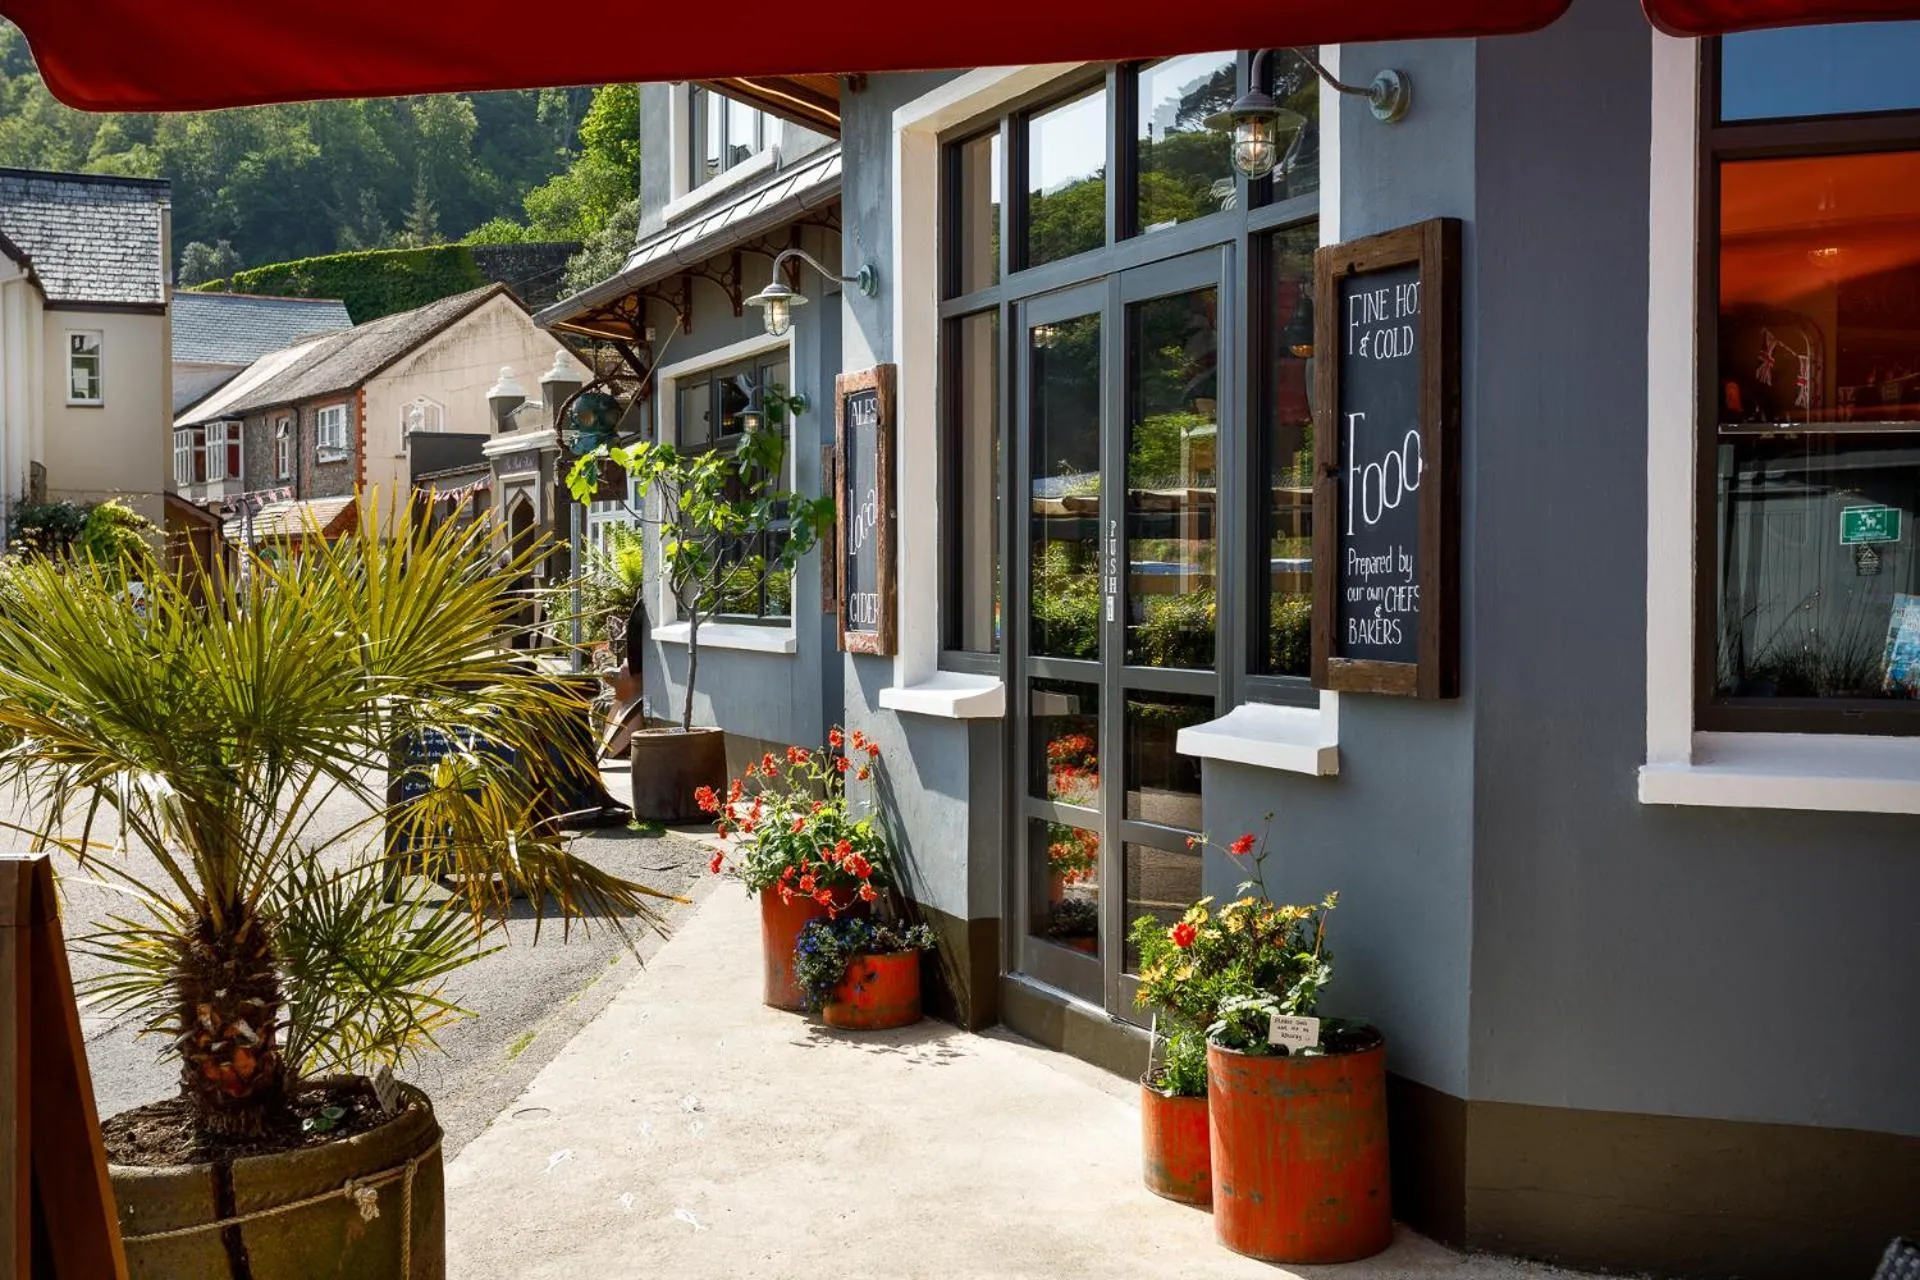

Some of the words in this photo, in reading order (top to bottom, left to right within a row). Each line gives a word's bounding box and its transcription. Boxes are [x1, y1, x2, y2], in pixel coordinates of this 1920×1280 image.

[1349, 288, 1389, 355] FINE
[1374, 325, 1414, 360] COLD
[1348, 545, 1392, 583] Prepared
[1398, 543, 1413, 583] by
[1347, 586, 1364, 602] our
[1366, 585, 1384, 602] own
[1348, 618, 1402, 645] BAKERS
